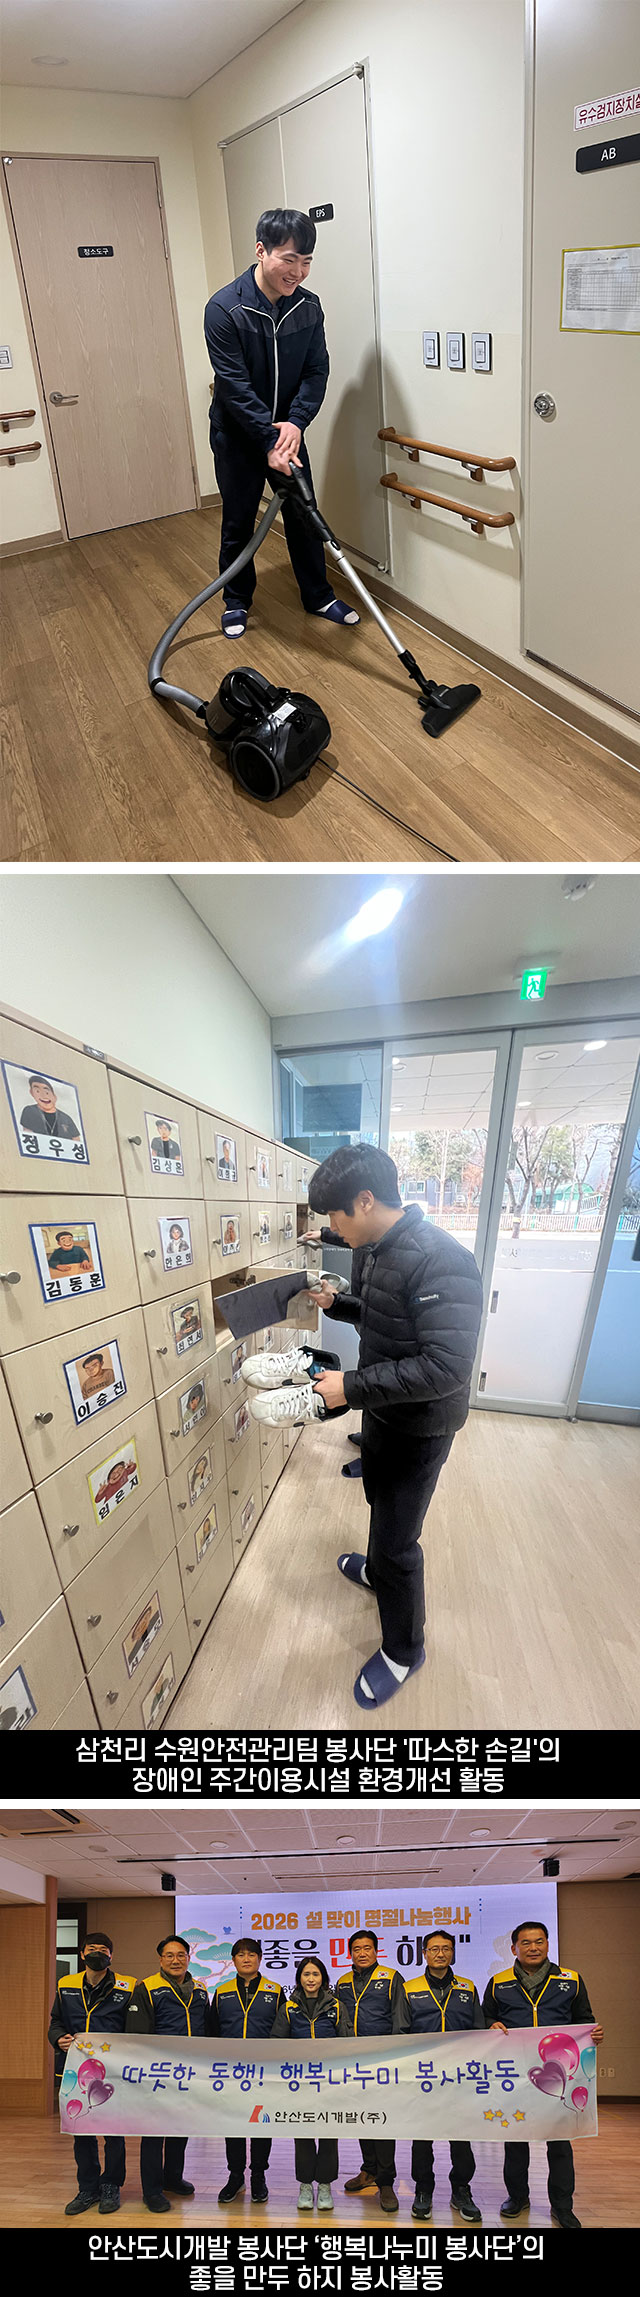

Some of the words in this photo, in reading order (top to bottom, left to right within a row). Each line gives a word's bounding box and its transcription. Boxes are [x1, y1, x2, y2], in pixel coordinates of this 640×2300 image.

[600, 147, 616, 161] AB
[315, 208, 326, 218] EPS
[22, 1134, 86, 1161] 정우성
[46, 1273, 102, 1298] 김동훈
[78, 1381, 124, 1418] 이승진
[98, 1475, 139, 1520] 임은지
[251, 1912, 299, 1931] 2026
[306, 1911, 323, 1929] 설
[327, 1909, 361, 1929] 맞이
[365, 1906, 471, 1928] 명절나눔행사
[396, 1934, 471, 1967] 하"
[122, 2062, 197, 2092] 따뜻한
[208, 2062, 265, 2092] 동행!
[280, 2061, 399, 2093] 행복나누미
[415, 2060, 520, 2094] 봉사활동
[274, 2111, 388, 2125] 안산도시개발(주)
